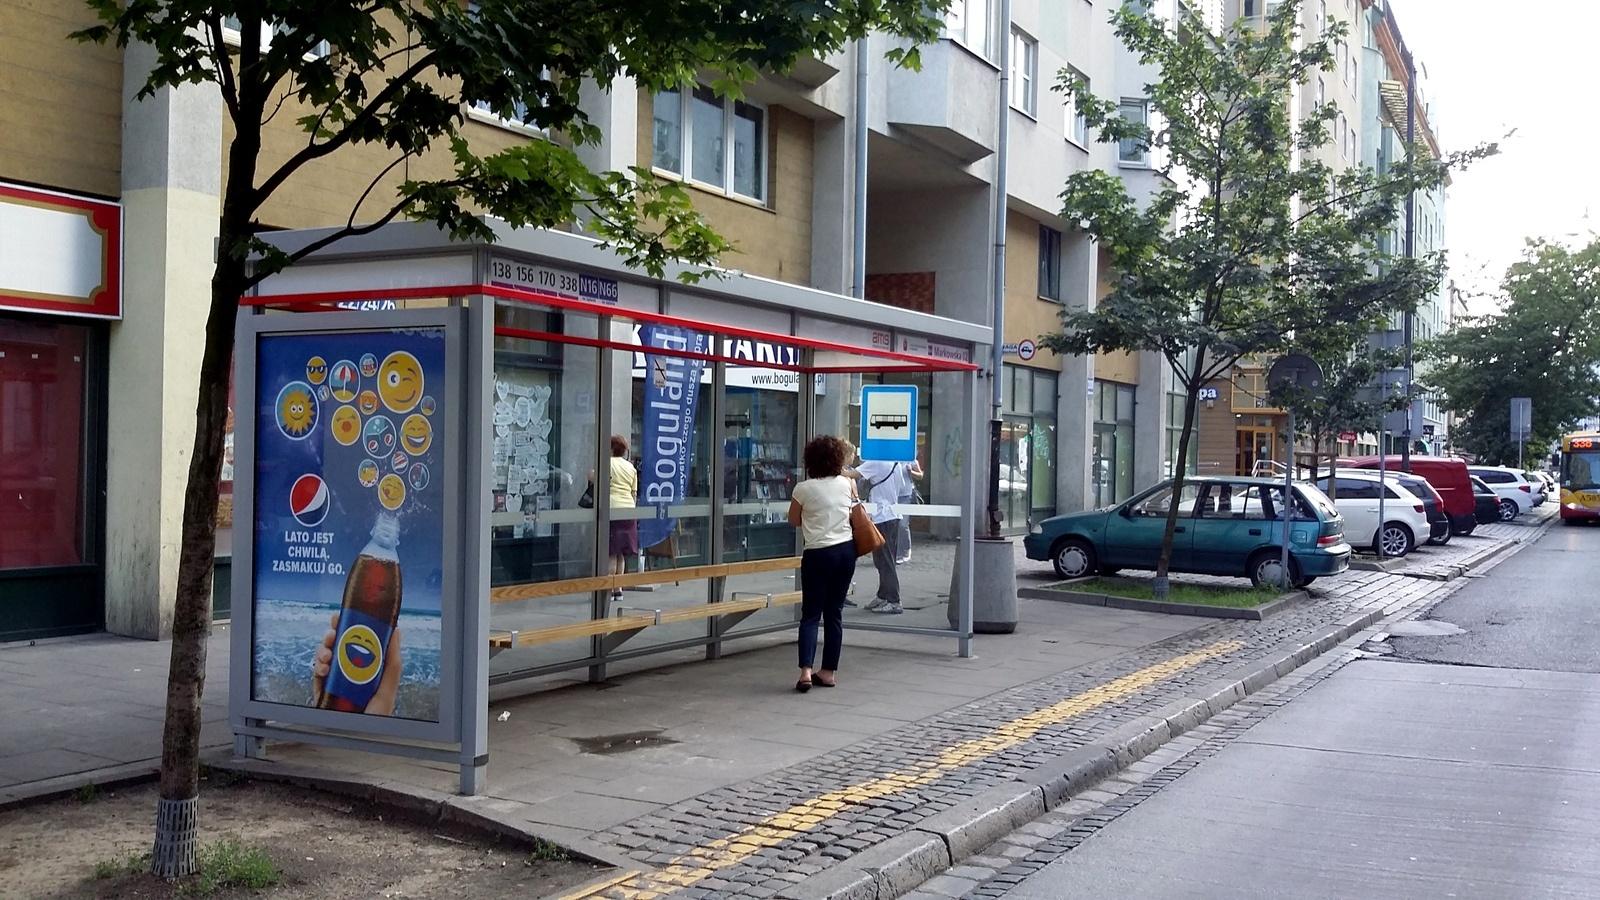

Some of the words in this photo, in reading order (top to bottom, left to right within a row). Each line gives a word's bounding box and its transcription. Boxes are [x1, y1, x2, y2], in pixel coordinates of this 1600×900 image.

[492, 262, 512, 279] 138
[516, 266, 534, 283] 156
[538, 270, 556, 287] 170
[559, 274, 578, 292] 338
[580, 277, 598, 293] N16
[599, 281, 618, 298] N66
[872, 330, 889, 346] ams
[933, 346, 962, 361] Markowska
[685, 369, 697, 405] dusza
[682, 408, 692, 443] czego
[285, 531, 310, 543] LATO
[311, 532, 334, 544] JEST
[288, 546, 330, 561] CHWILĄ.
[272, 560, 326, 574] ZASMAKUJ
[328, 563, 346, 575] GO.
